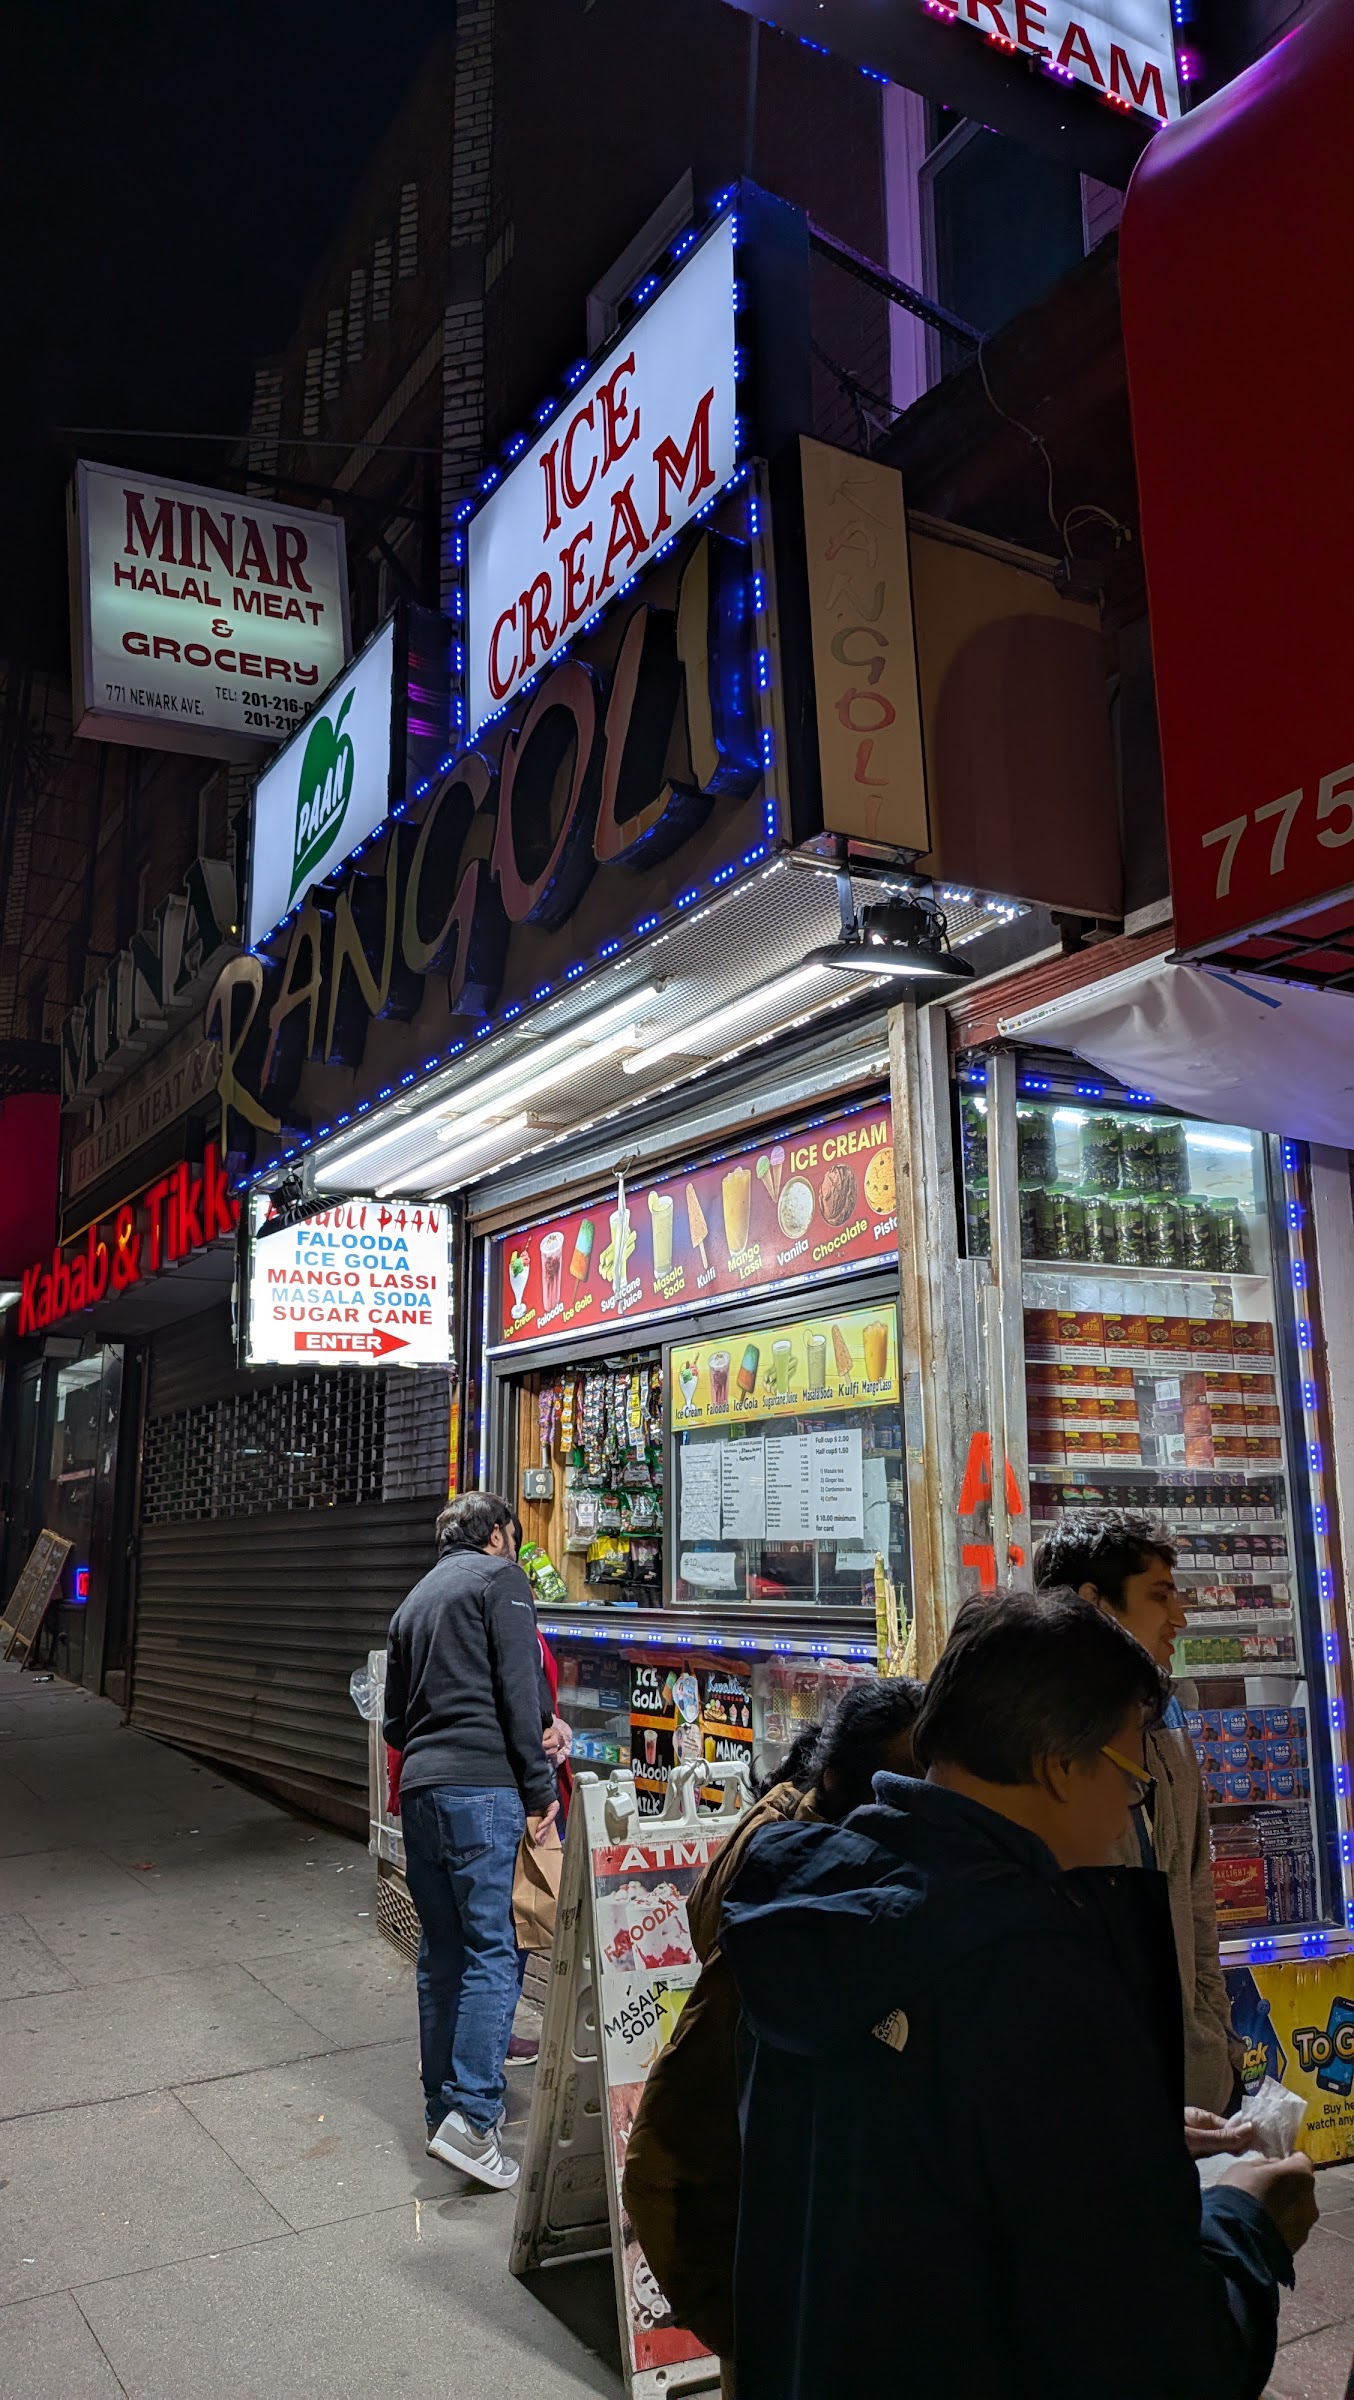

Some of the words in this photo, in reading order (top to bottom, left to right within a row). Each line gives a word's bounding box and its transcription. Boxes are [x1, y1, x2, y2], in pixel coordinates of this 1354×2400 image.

[946, 0, 1169, 120] REAM
[539, 350, 642, 543] ICE
[122, 488, 313, 593] MINAR
[488, 386, 716, 700] CREAM
[113, 561, 222, 607] HALAL
[233, 587, 325, 627] MEAT
[211, 618, 234, 638] &
[121, 631, 319, 685] GROCERY
[105, 684, 126, 703] 771
[130, 688, 178, 713] NEWARK
[181, 697, 204, 716] AVE.
[215, 686, 238, 702] TEL:
[297, 744, 350, 842] PAAN
[1201, 761, 1354, 900] 775
[205, 533, 722, 1161] RANGOLI
[137, 1069, 186, 1138] MEAT
[789, 1144, 819, 1174] ICE
[821, 1120, 889, 1165] CREAM
[377, 1205, 441, 1234] PAAN
[297, 1231, 409, 1252] FALOODA
[776, 1238, 810, 1267] Vanila
[812, 1218, 868, 1262] Chocolate
[17, 1223, 109, 1338] Kabab
[111, 1204, 142, 1292] &
[295, 1250, 335, 1267] ICE
[344, 1253, 410, 1271] GOLA
[727, 1244, 761, 1272] Mango
[738, 1257, 763, 1280] Lassi
[267, 1268, 361, 1287] MANGO
[369, 1273, 437, 1290] LASSI
[653, 1264, 684, 1294] Masala
[663, 1278, 685, 1300] Soda
[696, 1266, 717, 1289] Kulfi
[271, 1287, 366, 1305] MASALA
[373, 1291, 432, 1307] SODA
[562, 1310, 574, 1323] Ice
[574, 1293, 593, 1313] Gola
[600, 1277, 641, 1314] Sugrcane
[622, 1289, 643, 1311] Juice
[272, 1305, 360, 1323] SUGAR
[368, 1309, 433, 1325] CANE
[503, 1326, 514, 1339] Ice
[514, 1308, 536, 1331] Cream
[536, 1301, 565, 1329] Falooda
[1083, 1322, 1099, 1331] afzal
[306, 1334, 383, 1350] ENTER
[675, 1409, 684, 1420] Ice
[684, 1406, 703, 1419] Cream
[706, 1403, 729, 1416] Falooda
[733, 1400, 743, 1412] Ice
[744, 1397, 758, 1410] Gola
[802, 1388, 821, 1401] Masala
[820, 1387, 833, 1399] Soda
[838, 1381, 859, 1398] Kulfi
[862, 1380, 879, 1396] Mango
[636, 1667, 659, 1687] ICE
[632, 1688, 664, 1710] GOLA
[716, 1739, 751, 1766] MANGO
[619, 1843, 710, 1872] ATM
[603, 1899, 679, 1963] FALOODA
[604, 1980, 670, 2038] MASALA
[622, 2002, 669, 2045] SODA
[1307, 2115, 1335, 2131] watch
[1323, 2103, 1342, 2116] Buy
